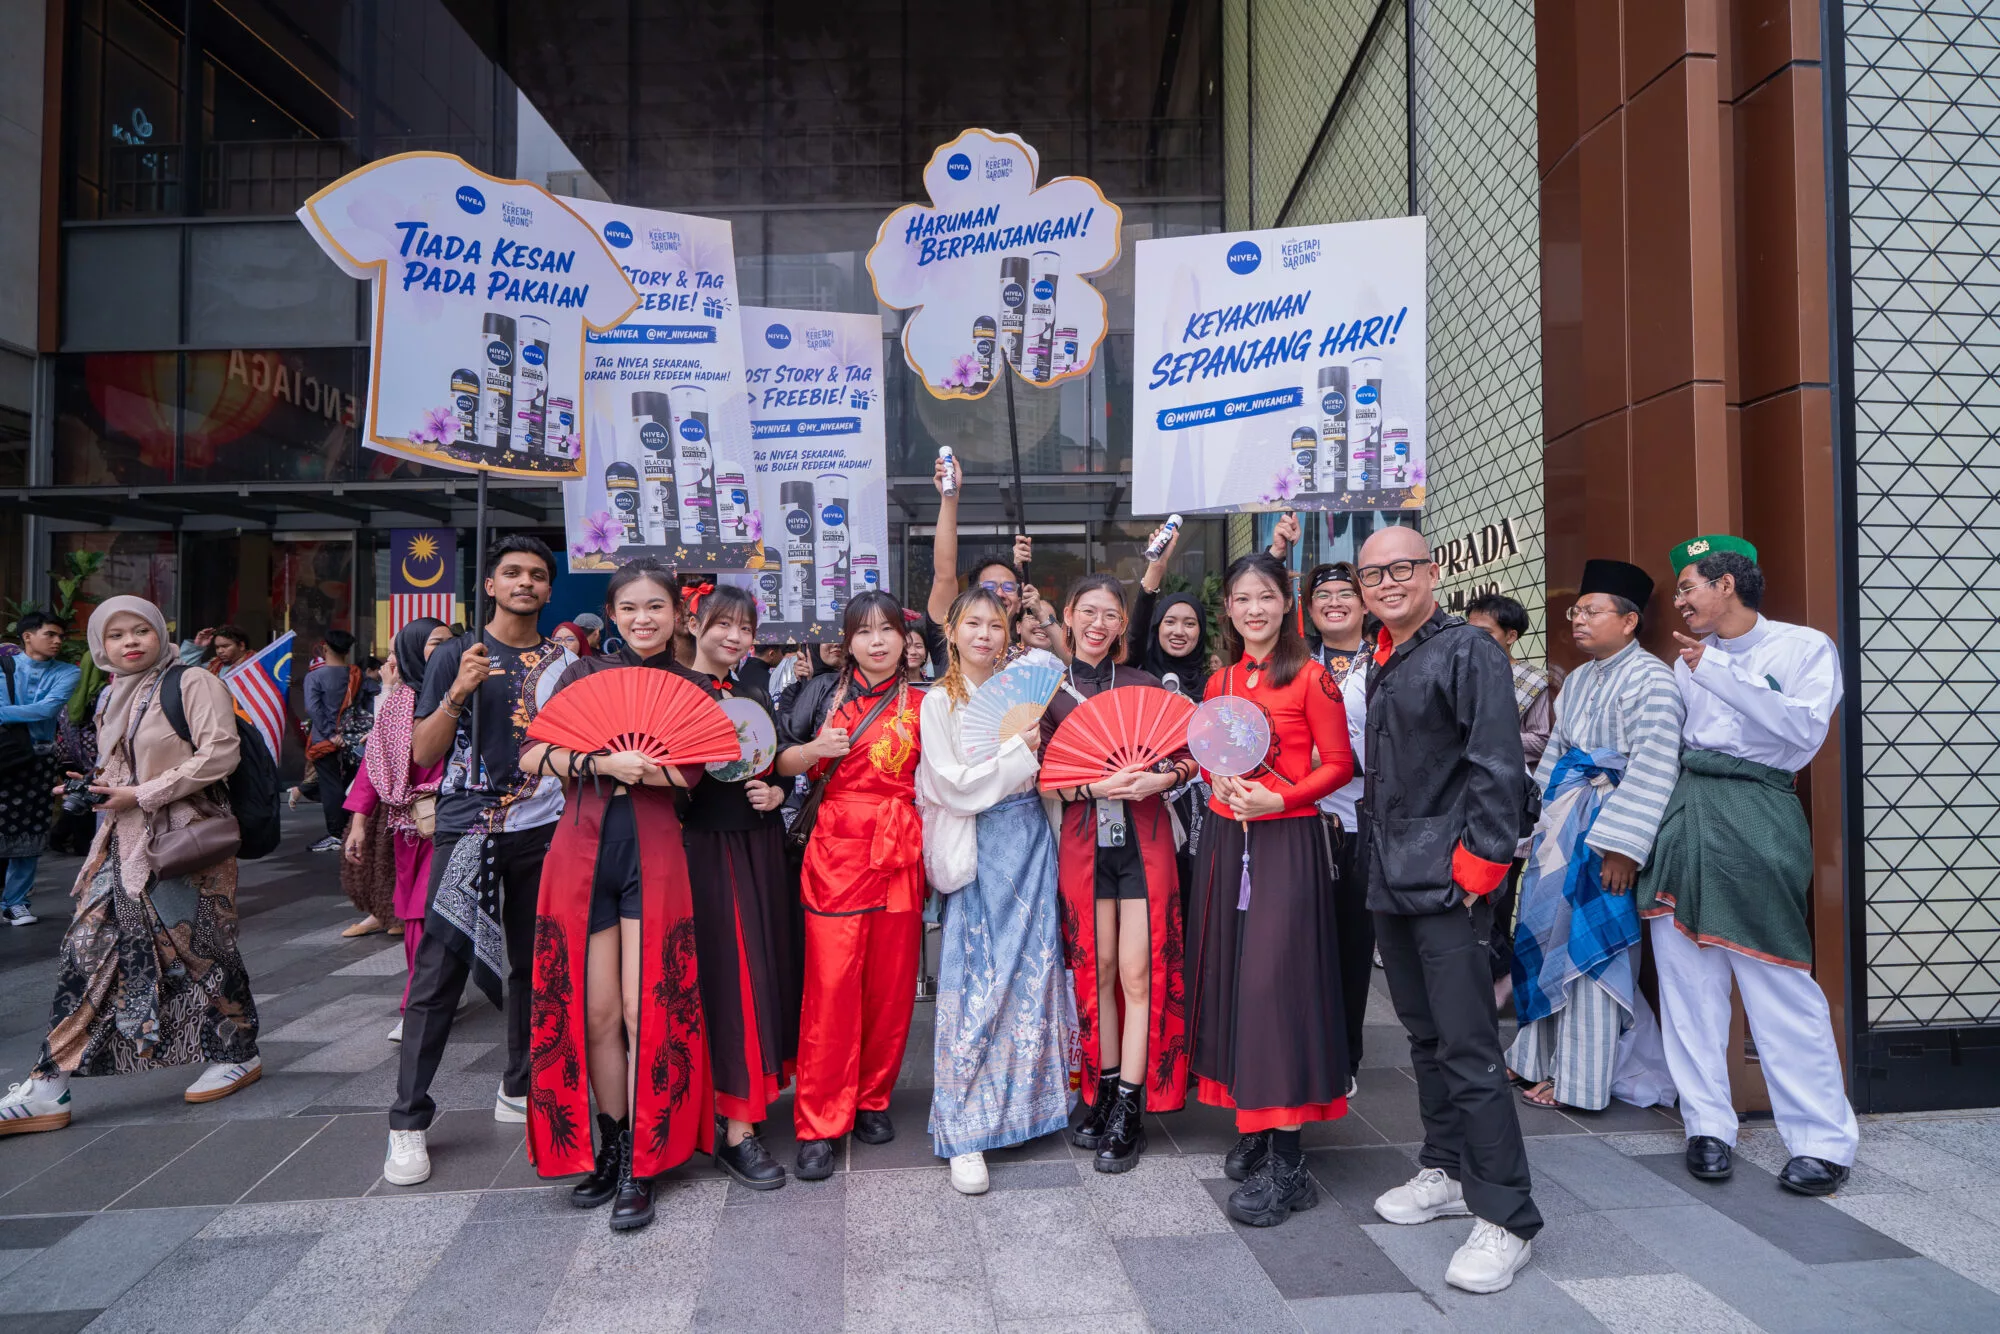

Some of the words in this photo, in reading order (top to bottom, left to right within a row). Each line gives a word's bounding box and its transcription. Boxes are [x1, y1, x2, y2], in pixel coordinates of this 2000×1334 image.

[986, 158, 1012, 170] KERETAPI
[986, 169, 1010, 181] SARONG
[458, 194, 482, 207] NIVEA
[502, 202, 532, 219] KERETAPI
[502, 214, 529, 227] SARONG
[905, 204, 1000, 245] HARUMAN
[606, 230, 631, 239] NIVEA
[649, 231, 680, 241] KERETAPI
[917, 208, 1094, 266] BERPANJANGAN!
[394, 222, 481, 264] TIADA
[491, 237, 576, 274] KESAN
[652, 241, 678, 253] SARONG
[1281, 239, 1320, 255] KERETAPI
[1230, 253, 1258, 262] NIVEA
[1283, 252, 1316, 270] SARONG
[403, 261, 476, 296] PADA
[487, 271, 590, 308] PAKAIAN
[676, 270, 688, 288] &
[695, 271, 724, 289] TAG
[1182, 290, 1312, 344] KEYAKINAN
[646, 328, 708, 340] @MY_NIVEAMEN
[806, 330, 834, 340] KERETAPI
[489, 348, 510, 357] NIVEA
[807, 340, 831, 352] SARONG
[1149, 328, 1313, 390] SEPANJANG
[1318, 306, 1408, 358] HARI!
[524, 350, 542, 360] NIVEA
[595, 356, 614, 368] TAG
[617, 356, 648, 368] NIVEA
[652, 358, 703, 369] SEKARANG,
[488, 371, 506, 380] BLACK
[620, 370, 650, 380] BOLEH
[654, 370, 692, 380] REDEEM
[694, 371, 731, 382] HADIAH!
[774, 364, 824, 384] STORY
[827, 365, 839, 382] &
[845, 364, 872, 382] TAG
[488, 378, 508, 386] WHITE
[762, 384, 847, 410] FREEBIE!
[1164, 406, 1216, 427] @MYNIVEA
[1224, 394, 1294, 416] @MY_NIVEAMEN
[798, 422, 854, 434] @MY_NIVEAMEN
[770, 450, 798, 460] NIVEA
[800, 449, 846, 459] SEKARANG,
[646, 466, 669, 474] WHITE
[771, 462, 800, 472] BOLEH
[801, 460, 836, 470] REDEEM
[838, 459, 872, 469] HADIAH!
[1434, 517, 1520, 580] PRADA
